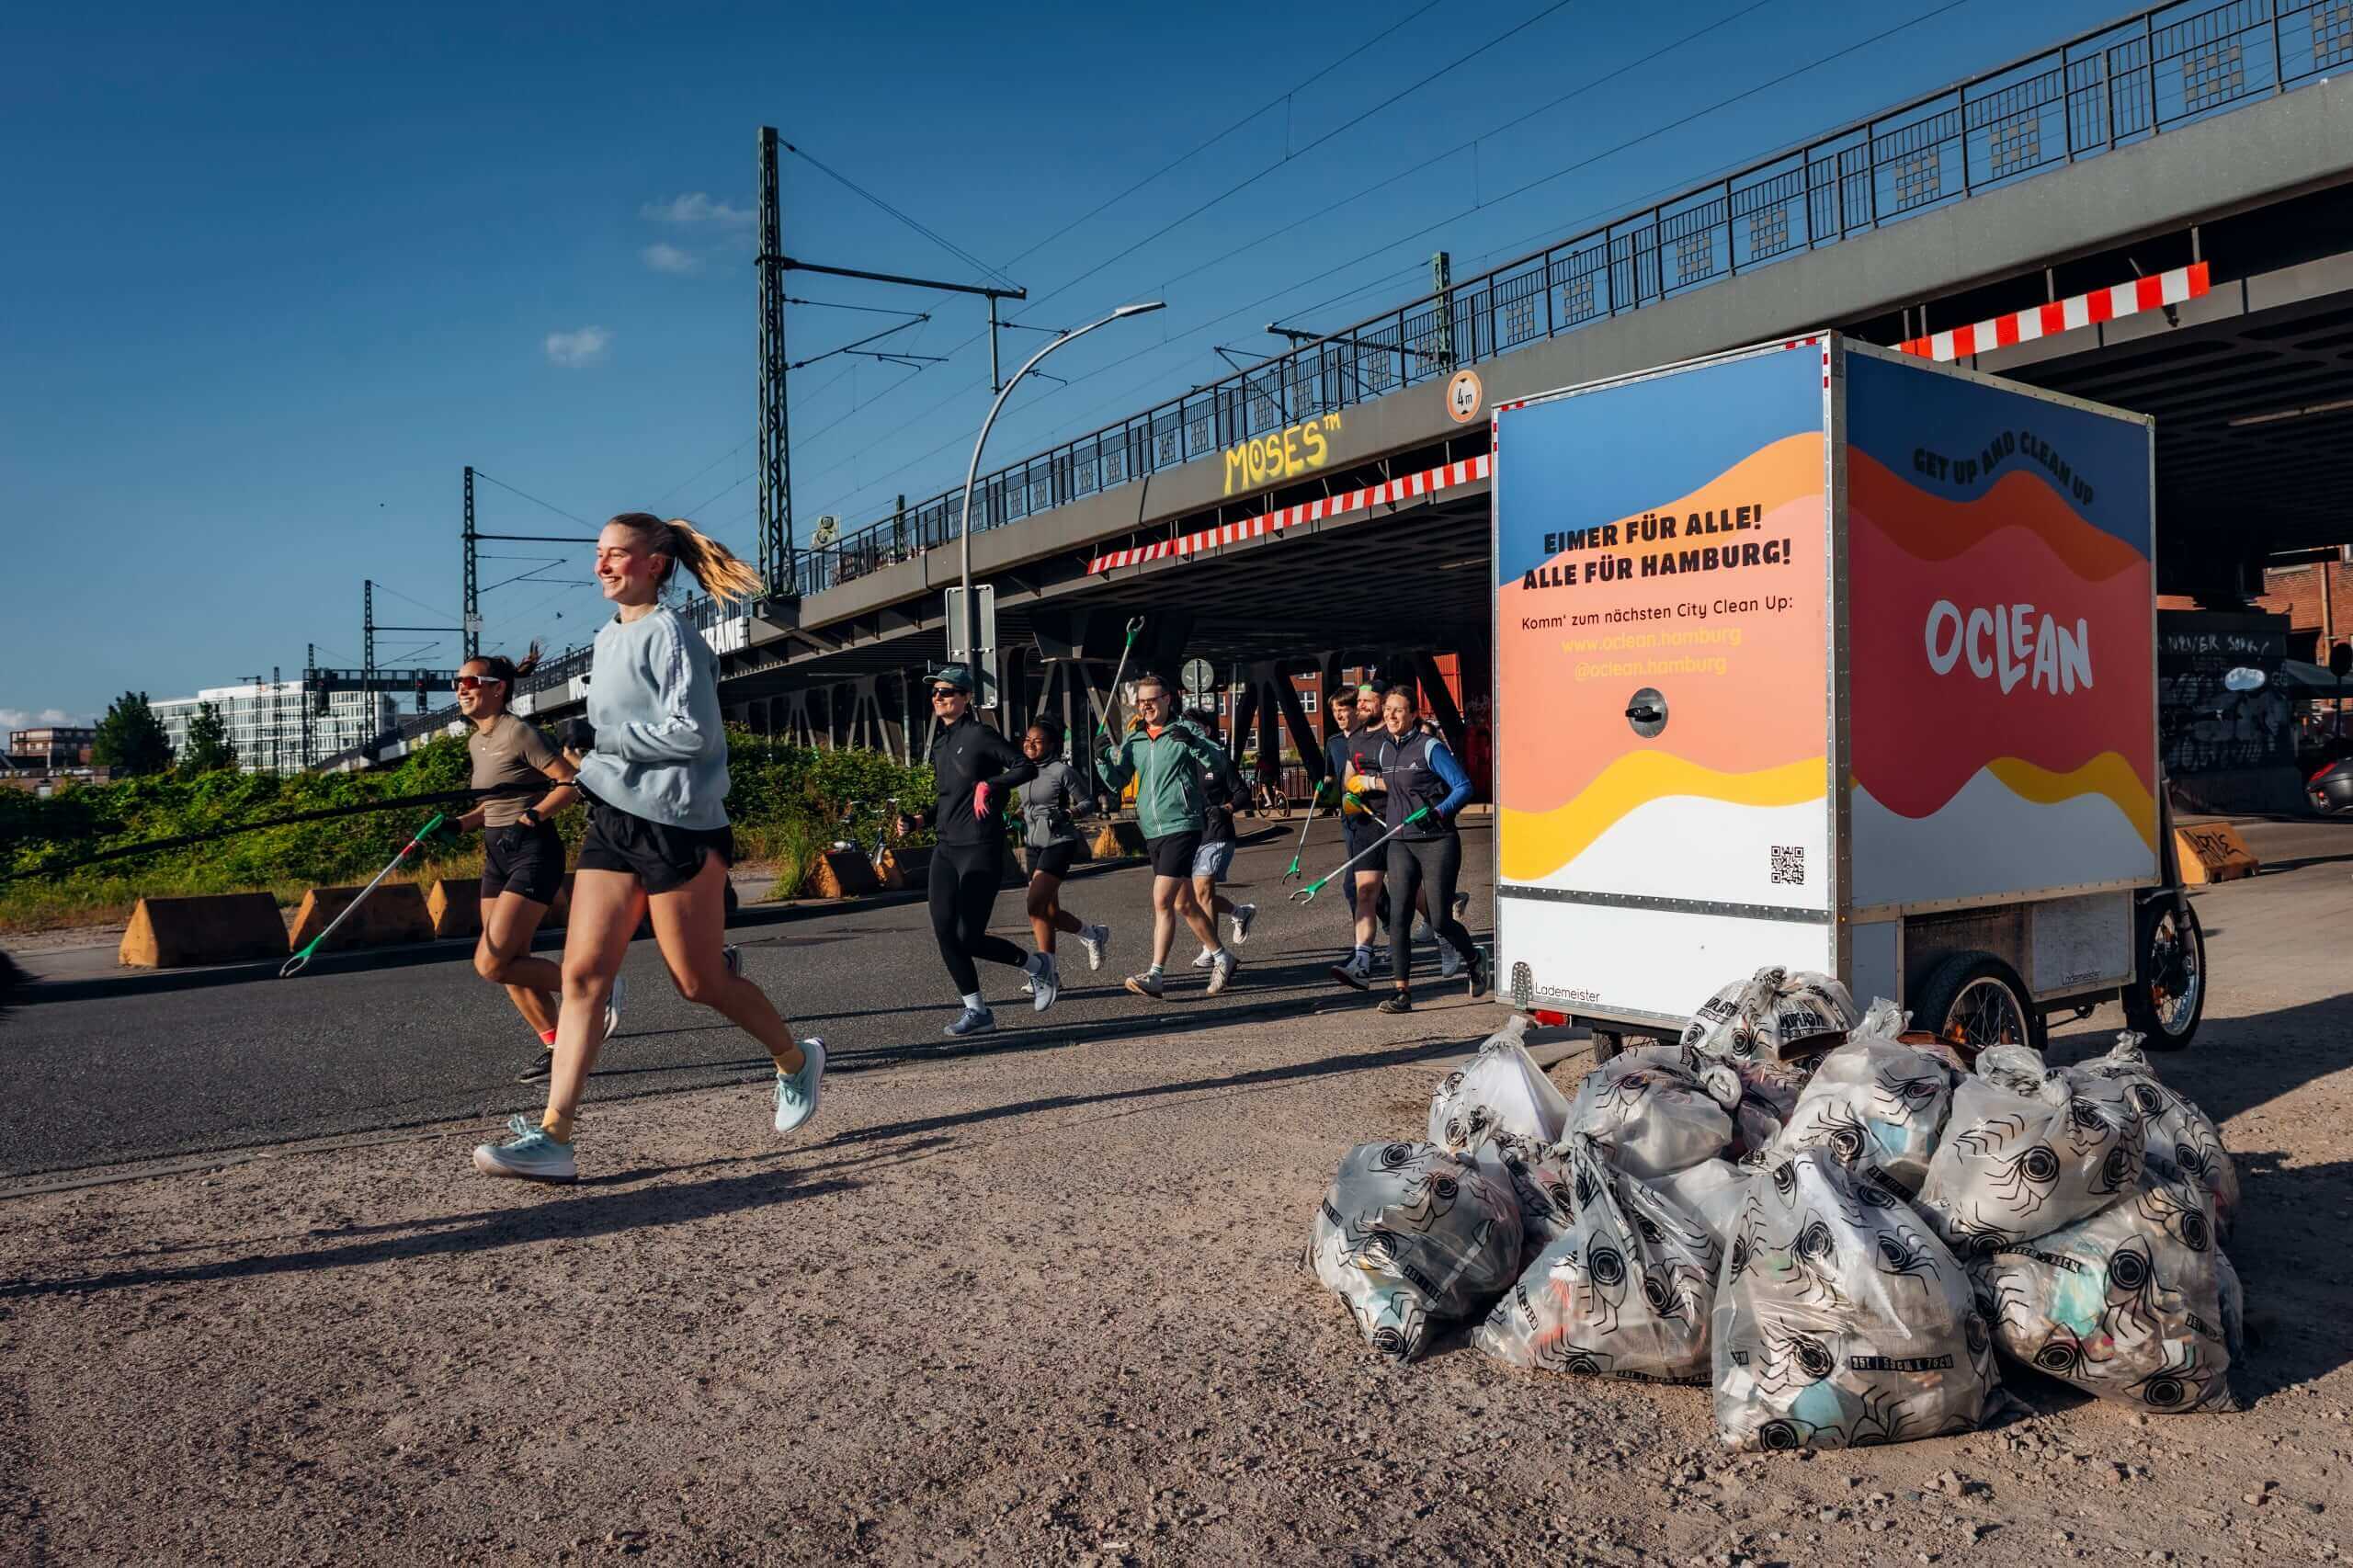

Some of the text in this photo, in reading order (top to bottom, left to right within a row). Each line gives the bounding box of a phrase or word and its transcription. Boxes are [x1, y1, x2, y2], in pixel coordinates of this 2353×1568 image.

[1913, 431, 2094, 506] GET UP AND CLEAN UP
[1544, 505, 1762, 554] EIMER FÜR ALLE!
[1522, 539, 1791, 590] ALLE FÜR HAMBURG!
[1572, 614, 1599, 627] zum
[1605, 606, 1671, 624] nächsten
[1677, 603, 1707, 619] City
[1713, 597, 1758, 616] Clean
[1766, 596, 1793, 612] Up:
[1562, 625, 1742, 653] www.oclean.hamburg
[1925, 599, 2094, 696] OCLEAN
[1574, 654, 1727, 681] @oclean.hamburg
[1534, 982, 1602, 1004] Lademeister
